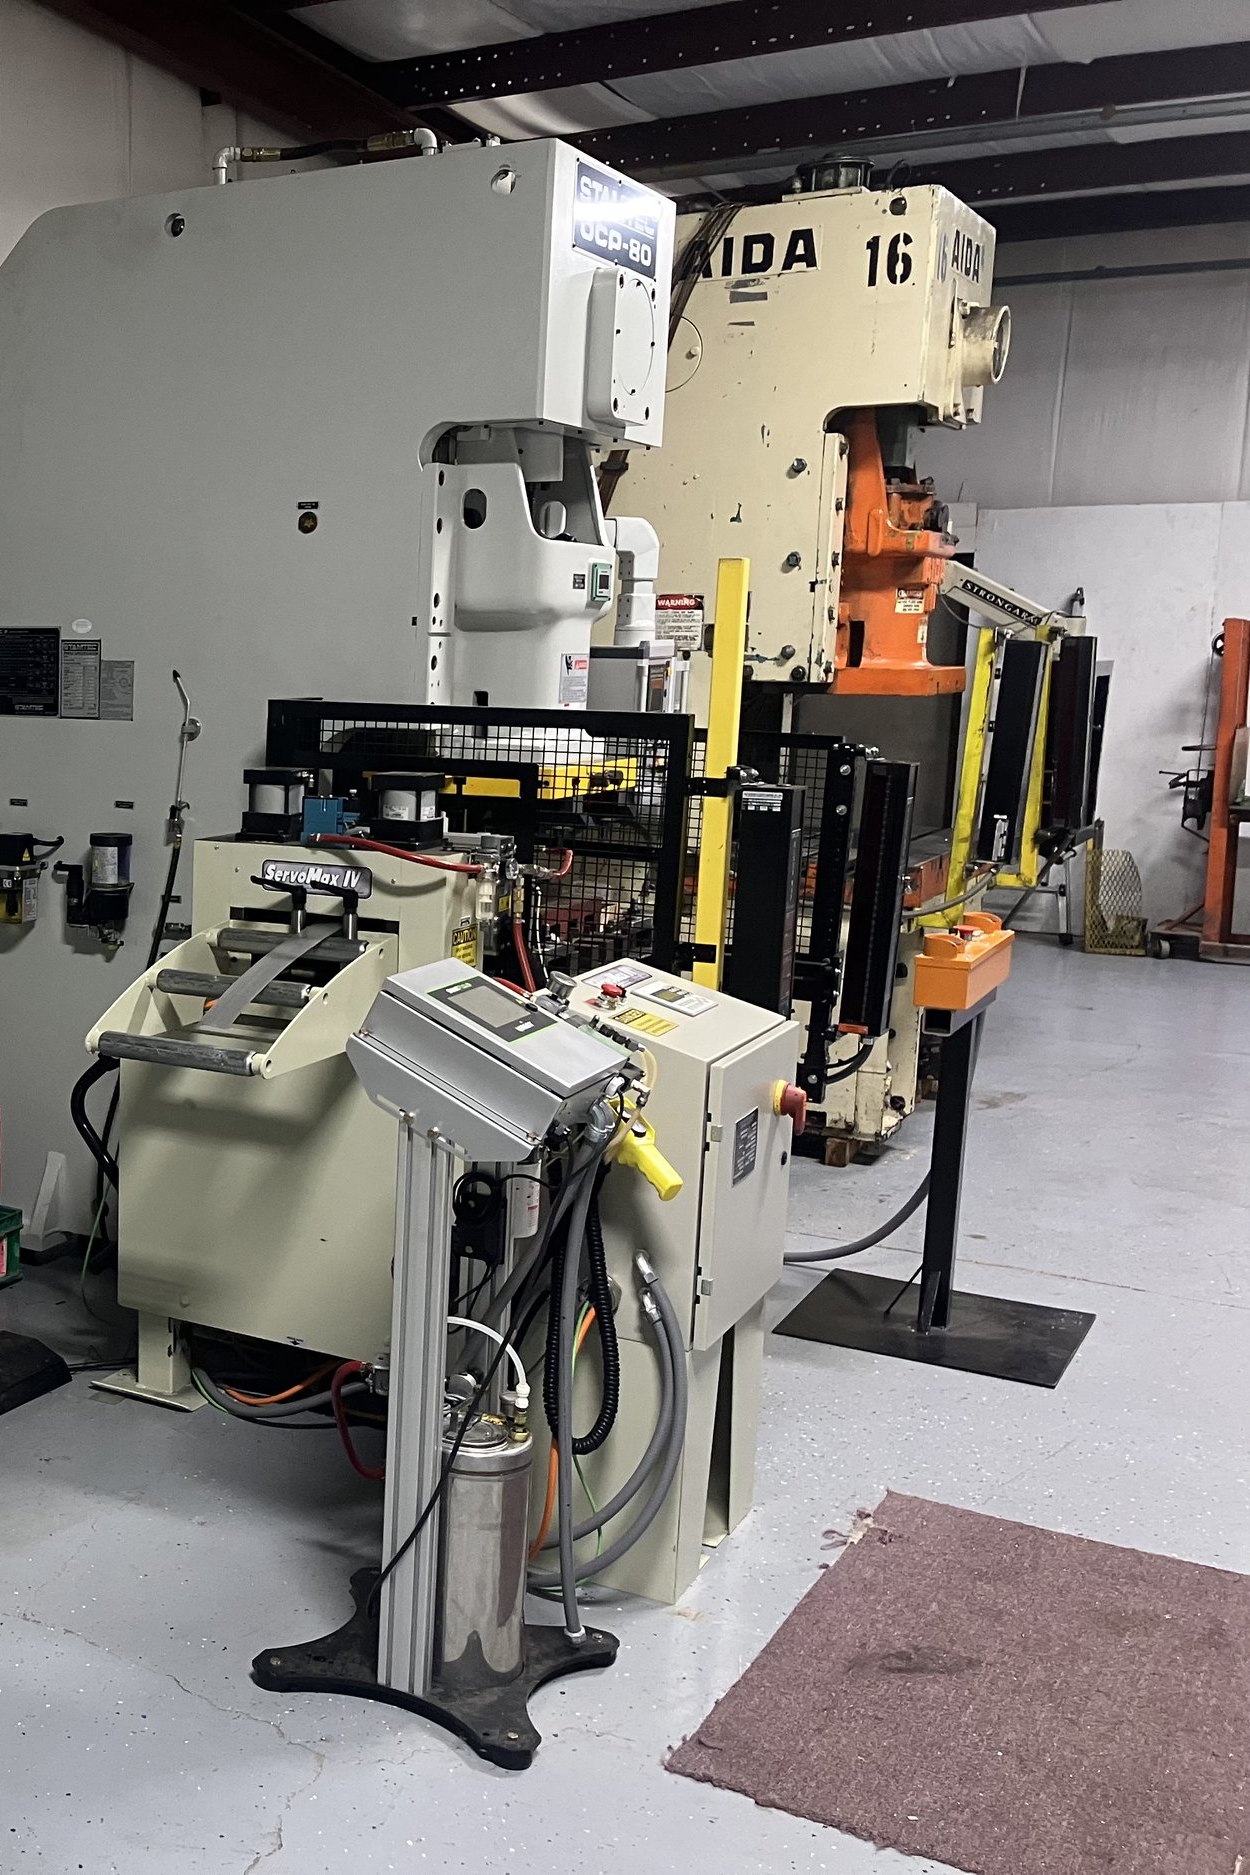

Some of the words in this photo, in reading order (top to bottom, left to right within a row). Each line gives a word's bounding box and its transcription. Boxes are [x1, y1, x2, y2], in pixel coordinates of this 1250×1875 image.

[866, 232, 913, 287] 16
[951, 229, 980, 283] AIDA
[965, 582, 1038, 625] STRONGARM
[265, 864, 340, 887] ServoMax
[343, 870, 361, 888] IV
